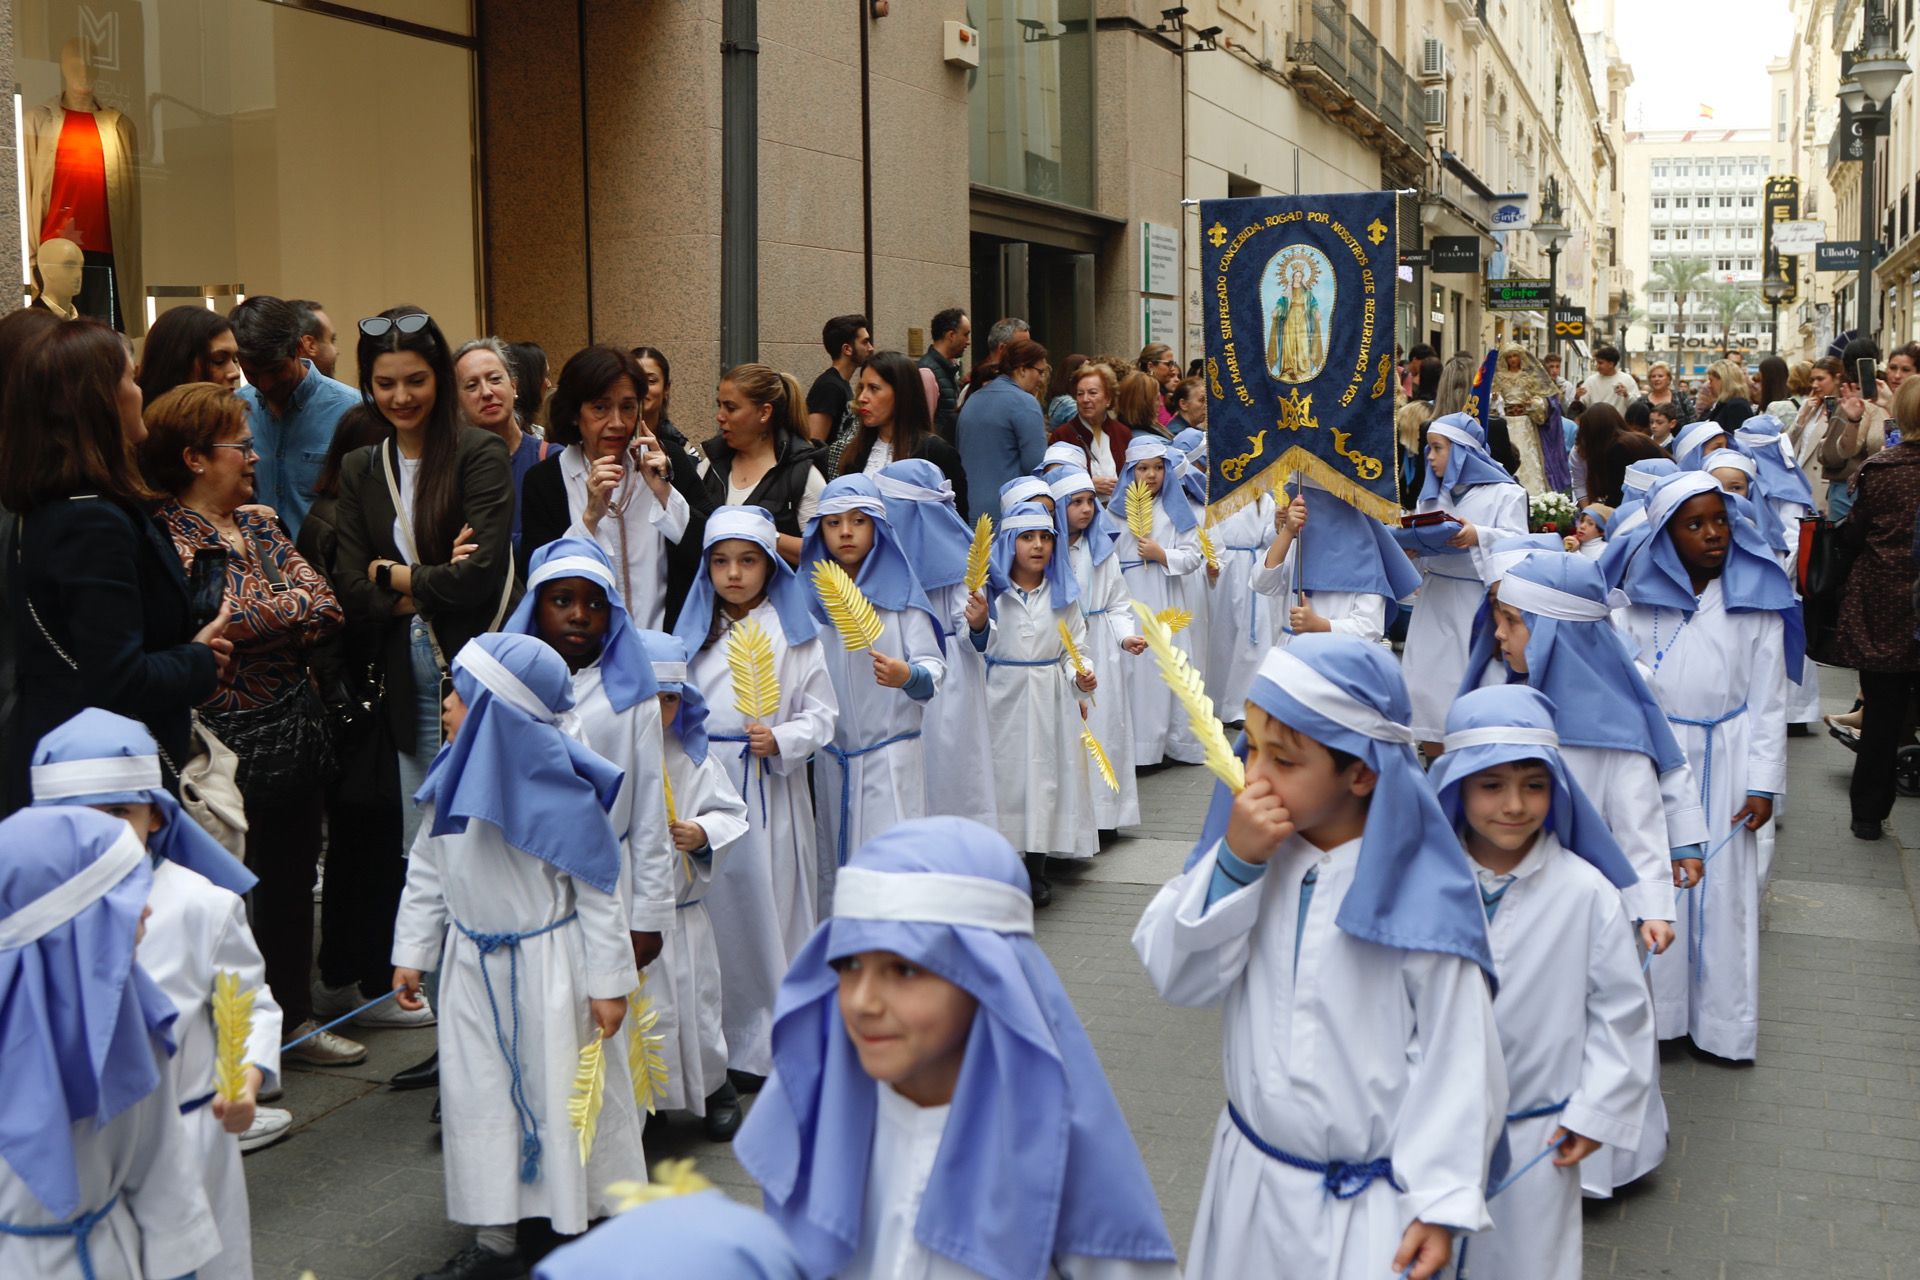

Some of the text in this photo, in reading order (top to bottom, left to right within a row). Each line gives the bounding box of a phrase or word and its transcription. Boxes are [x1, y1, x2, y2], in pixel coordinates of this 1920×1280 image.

[1264, 210, 1303, 227] ROGAD
[1307, 211, 1330, 224] POR
[1330, 220, 1369, 266] NOSOTROS
[1821, 248, 1845, 257] Ulloa
[1362, 268, 1376, 294] QUE
[1555, 312, 1583, 322] Ulloa
[1356, 297, 1376, 373] RECURRIMOS
[1223, 342, 1242, 384] MARÍA
[1352, 371, 1363, 382] A
